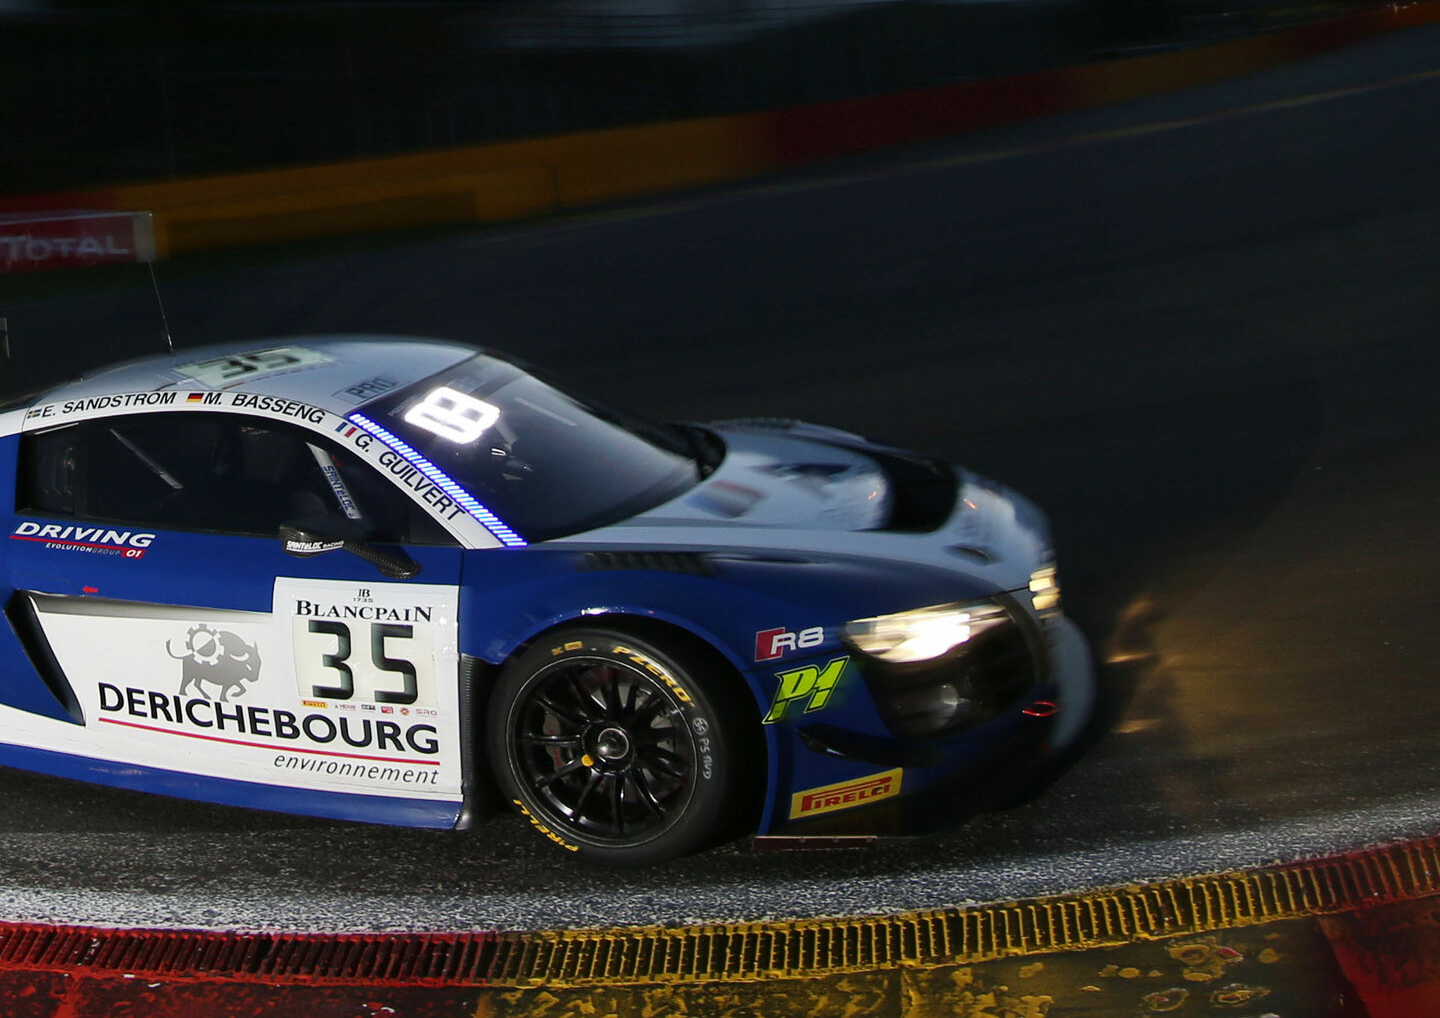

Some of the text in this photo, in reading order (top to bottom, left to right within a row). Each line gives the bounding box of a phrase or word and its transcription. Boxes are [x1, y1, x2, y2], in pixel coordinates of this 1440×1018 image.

[2, 234, 129, 261] TOTAL
[197, 347, 301, 379] 35
[41, 392, 177, 418] E. SANDSTROM
[203, 392, 326, 425] M. BASSENG
[354, 433, 466, 521] G. GUILVERT
[15, 522, 156, 548] DRIVING
[125, 549, 142, 558] 01
[295, 599, 433, 622] BLANCPAIN
[769, 626, 824, 656] R8
[308, 619, 419, 705] 35
[762, 655, 851, 724] P1
[98, 681, 440, 755] DERICHEBOURG
[274, 752, 440, 785] environnement
[801, 776, 893, 812] PIRELLI
[513, 799, 581, 852] PIRELLI
